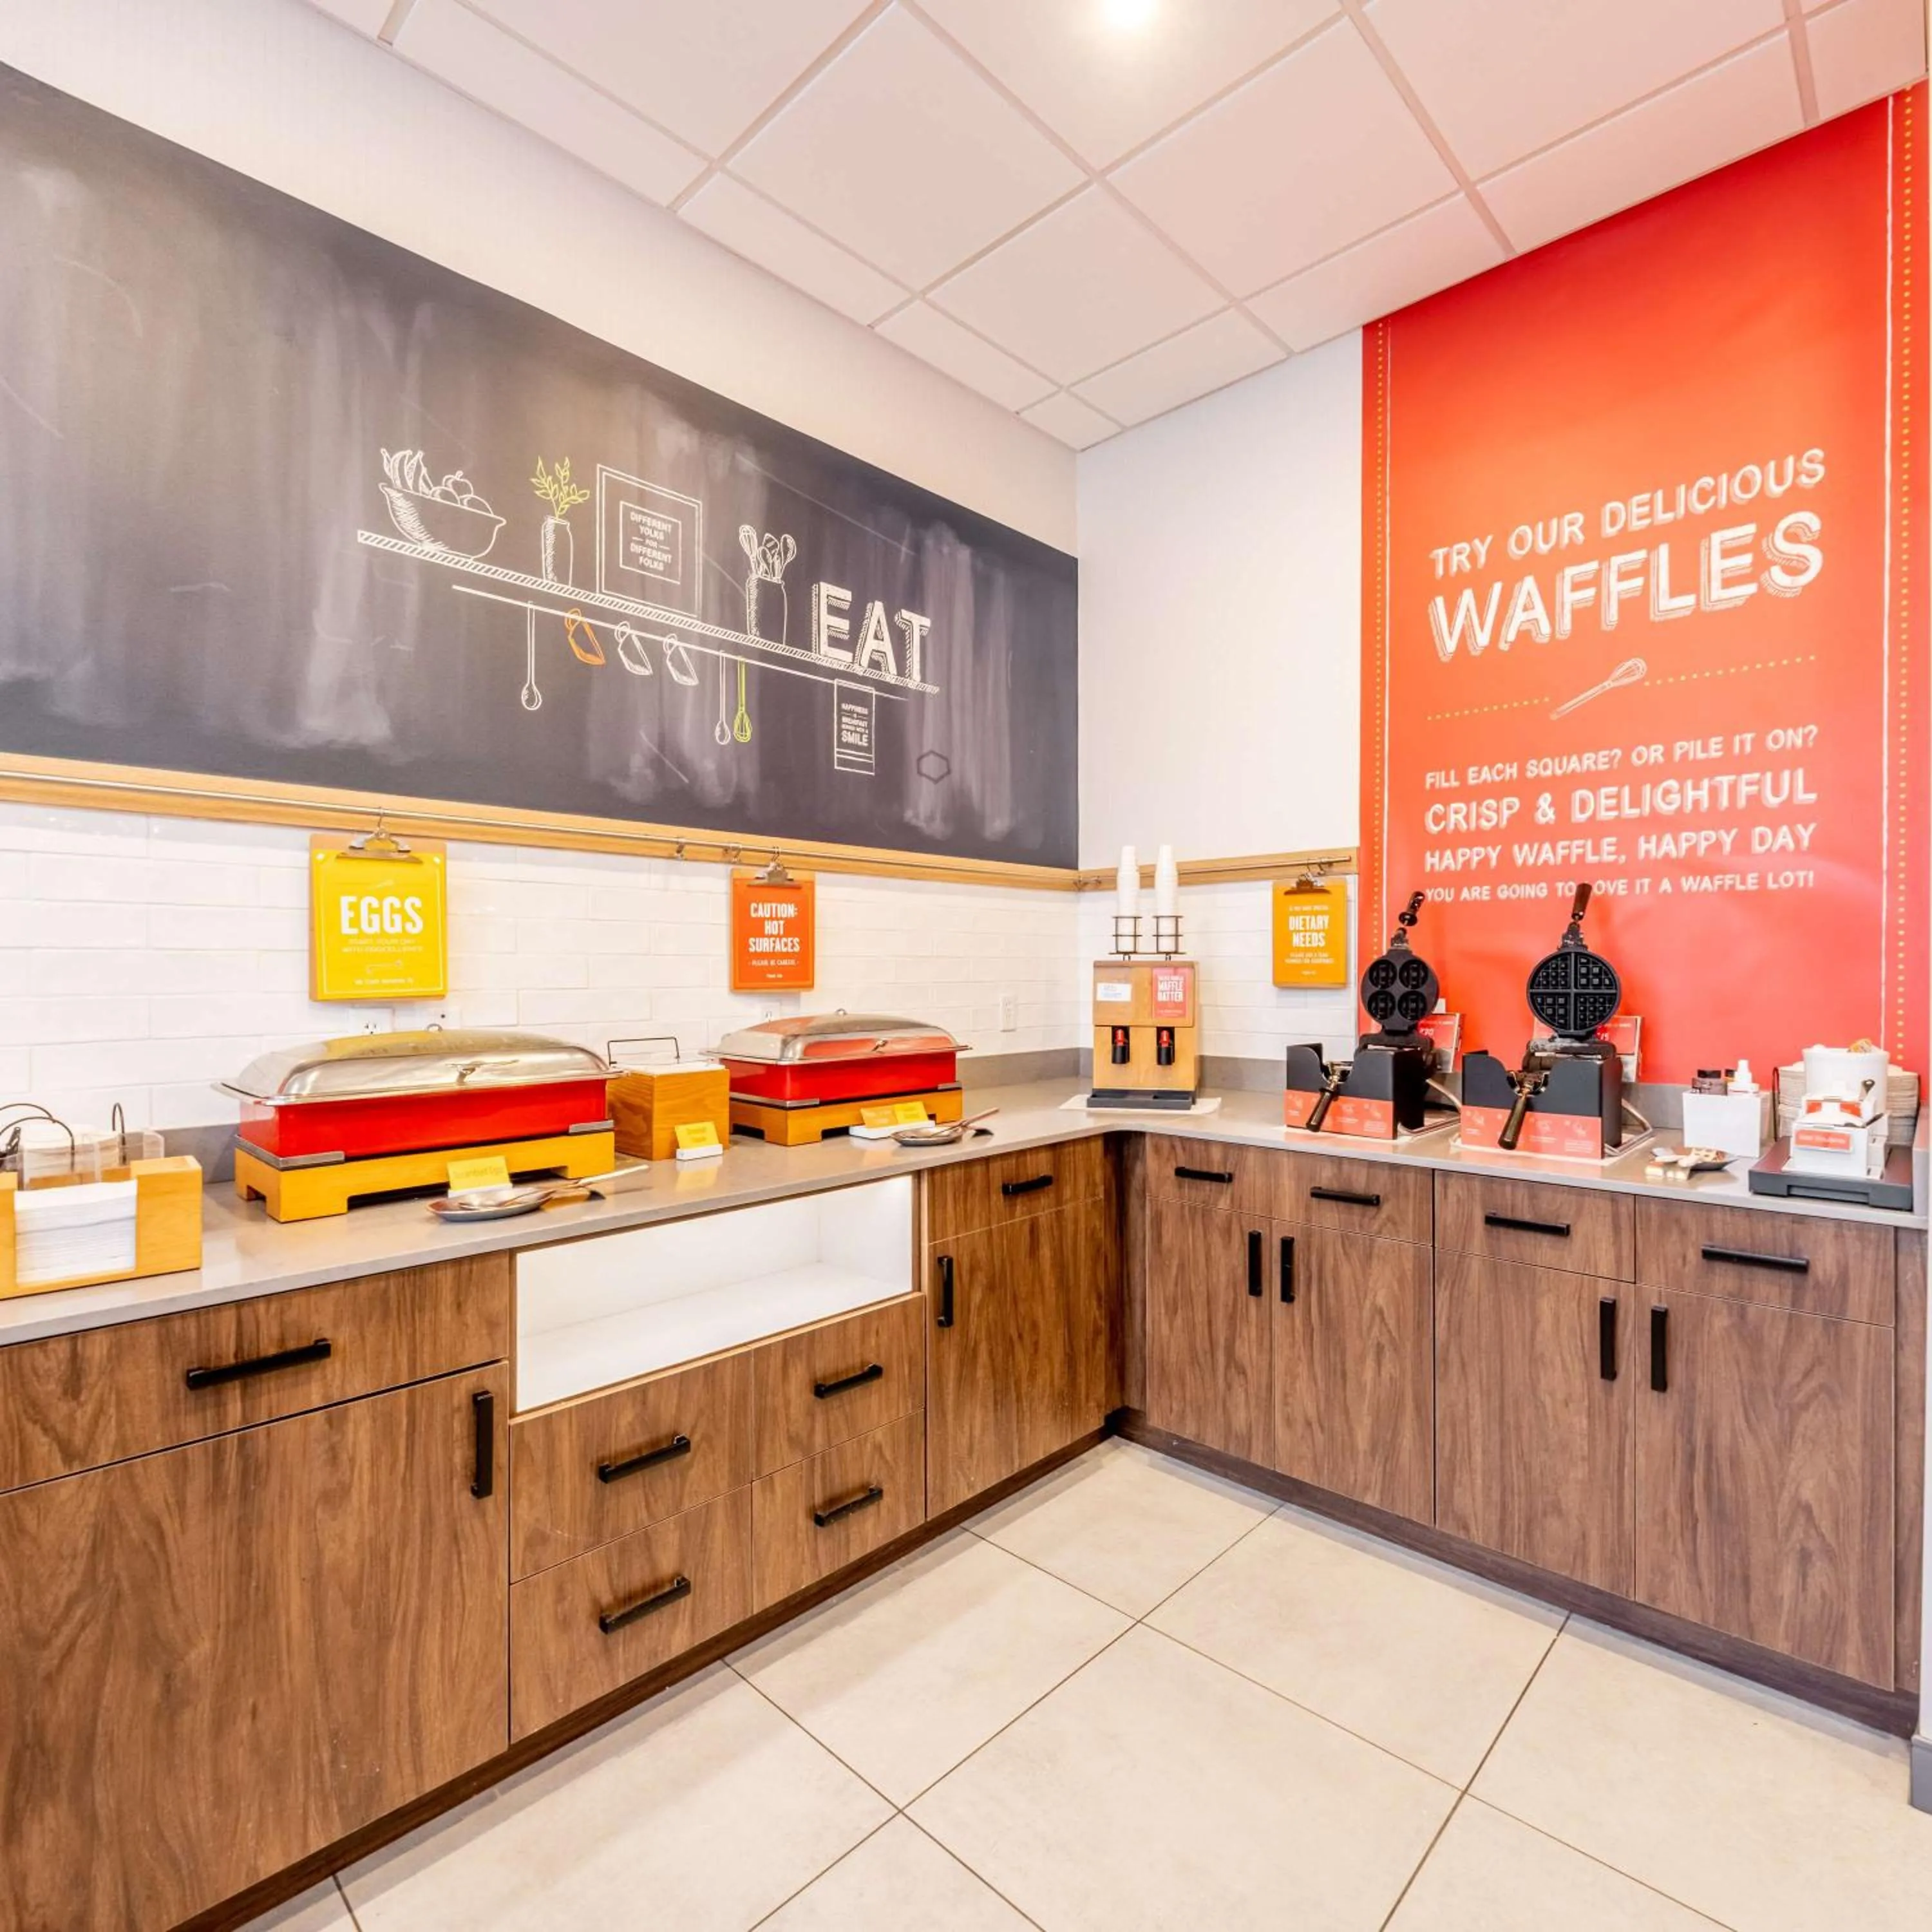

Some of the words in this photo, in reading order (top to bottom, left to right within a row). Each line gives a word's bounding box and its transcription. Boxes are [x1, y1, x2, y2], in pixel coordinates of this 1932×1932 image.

[630, 511, 671, 534] DIFFERENT
[1429, 535, 1493, 578] TRY
[1508, 513, 1584, 560] OUR
[1601, 448, 1825, 538] DELICIOUS
[630, 542, 672, 564] DIFFERENT
[1428, 511, 1823, 661] WAFFLES
[811, 582, 931, 681] EAT
[841, 730, 868, 746] SMILE
[1425, 770, 1460, 790] FILL
[1467, 762, 1518, 786] EACH
[1525, 748, 1622, 777] SQUARE?
[1631, 744, 1665, 767] OR
[1674, 736, 1724, 762] PILE
[1732, 732, 1756, 755] IT
[1766, 724, 1819, 750] ON?
[1424, 795, 1520, 834] CRISP
[1535, 792, 1556, 825] &
[1571, 768, 1817, 824] DELIGHTFUL
[1425, 844, 1502, 872] HAPPY
[1512, 837, 1627, 867] WAFFLE,
[1638, 828, 1738, 860] HAPPY
[1751, 822, 1817, 853] DAY
[1425, 887, 1455, 902] YOU
[1460, 885, 1490, 901] ARE
[1497, 883, 1548, 900] GOING
[1555, 882, 1576, 897] TO
[1588, 879, 1629, 896] OVE
[1634, 877, 1651, 896] IT
[1658, 876, 1672, 895] A
[1680, 872, 1759, 892] WAFFLE
[1766, 869, 1815, 889] LOT!
[340, 895, 423, 935] EGGS
[750, 903, 798, 918] CAUTION:
[764, 920, 785, 935] HOT
[1293, 933, 1325, 947] NEEDS
[748, 938, 800, 952] SURFACES
